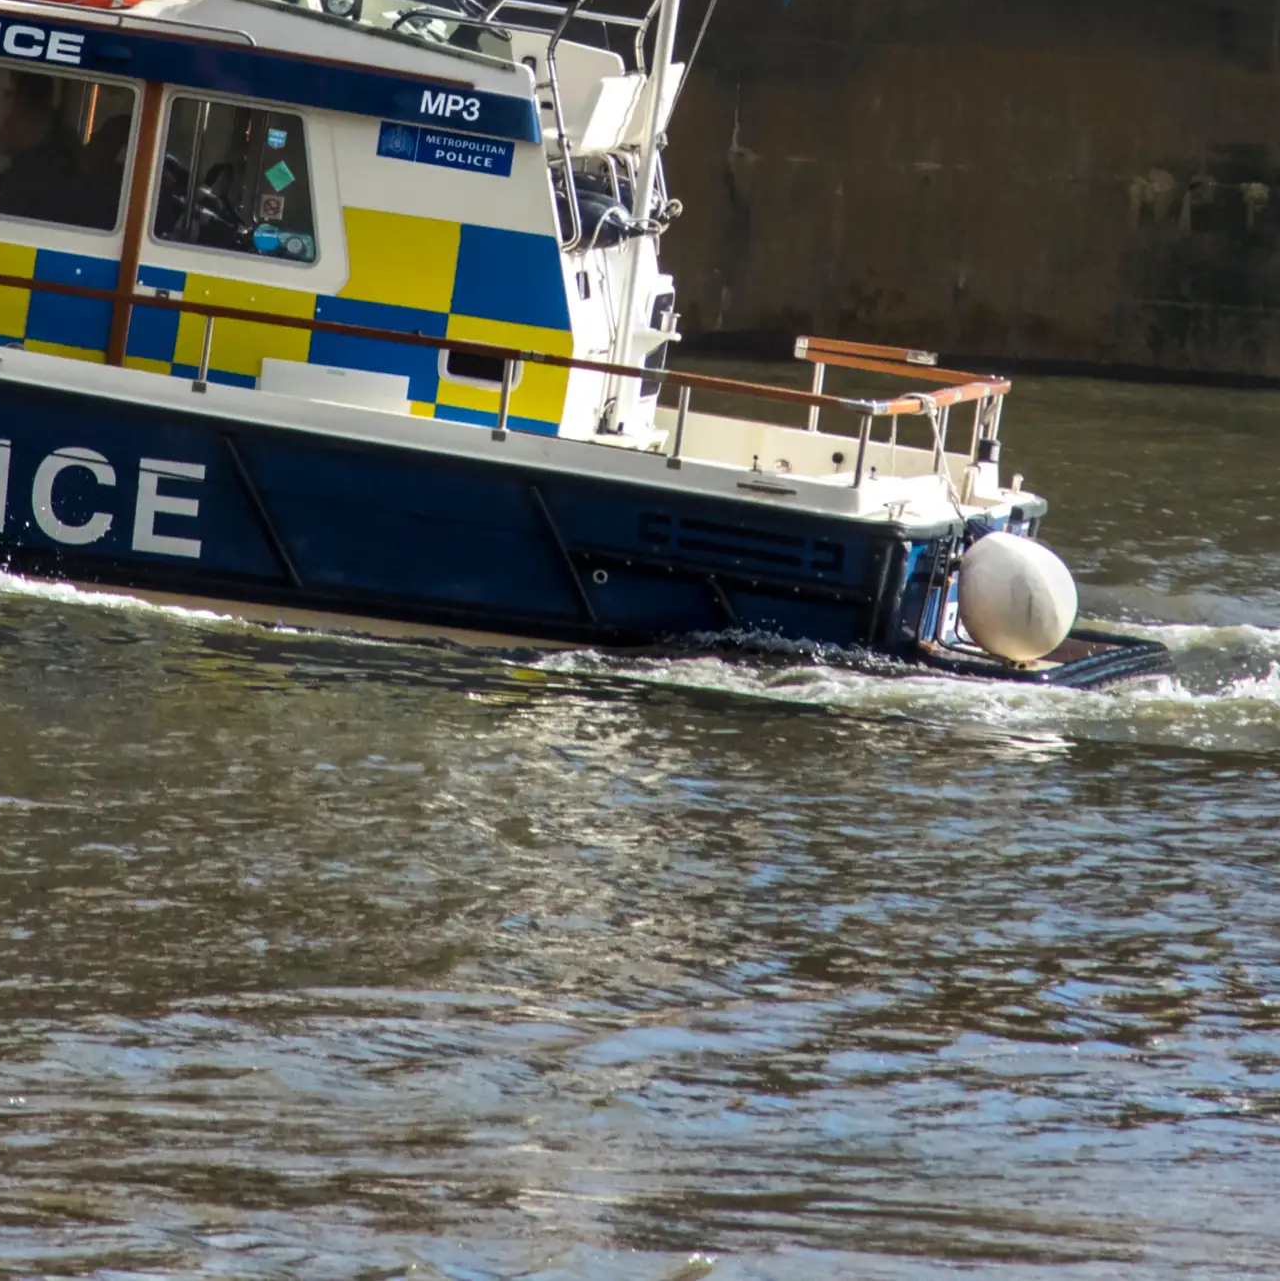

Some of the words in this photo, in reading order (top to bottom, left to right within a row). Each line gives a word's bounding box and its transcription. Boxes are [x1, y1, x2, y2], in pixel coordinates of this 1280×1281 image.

[420, 90, 481, 122] MP3
[425, 134, 506, 156] METROPOLITAN
[435, 149, 493, 168] POLICE
